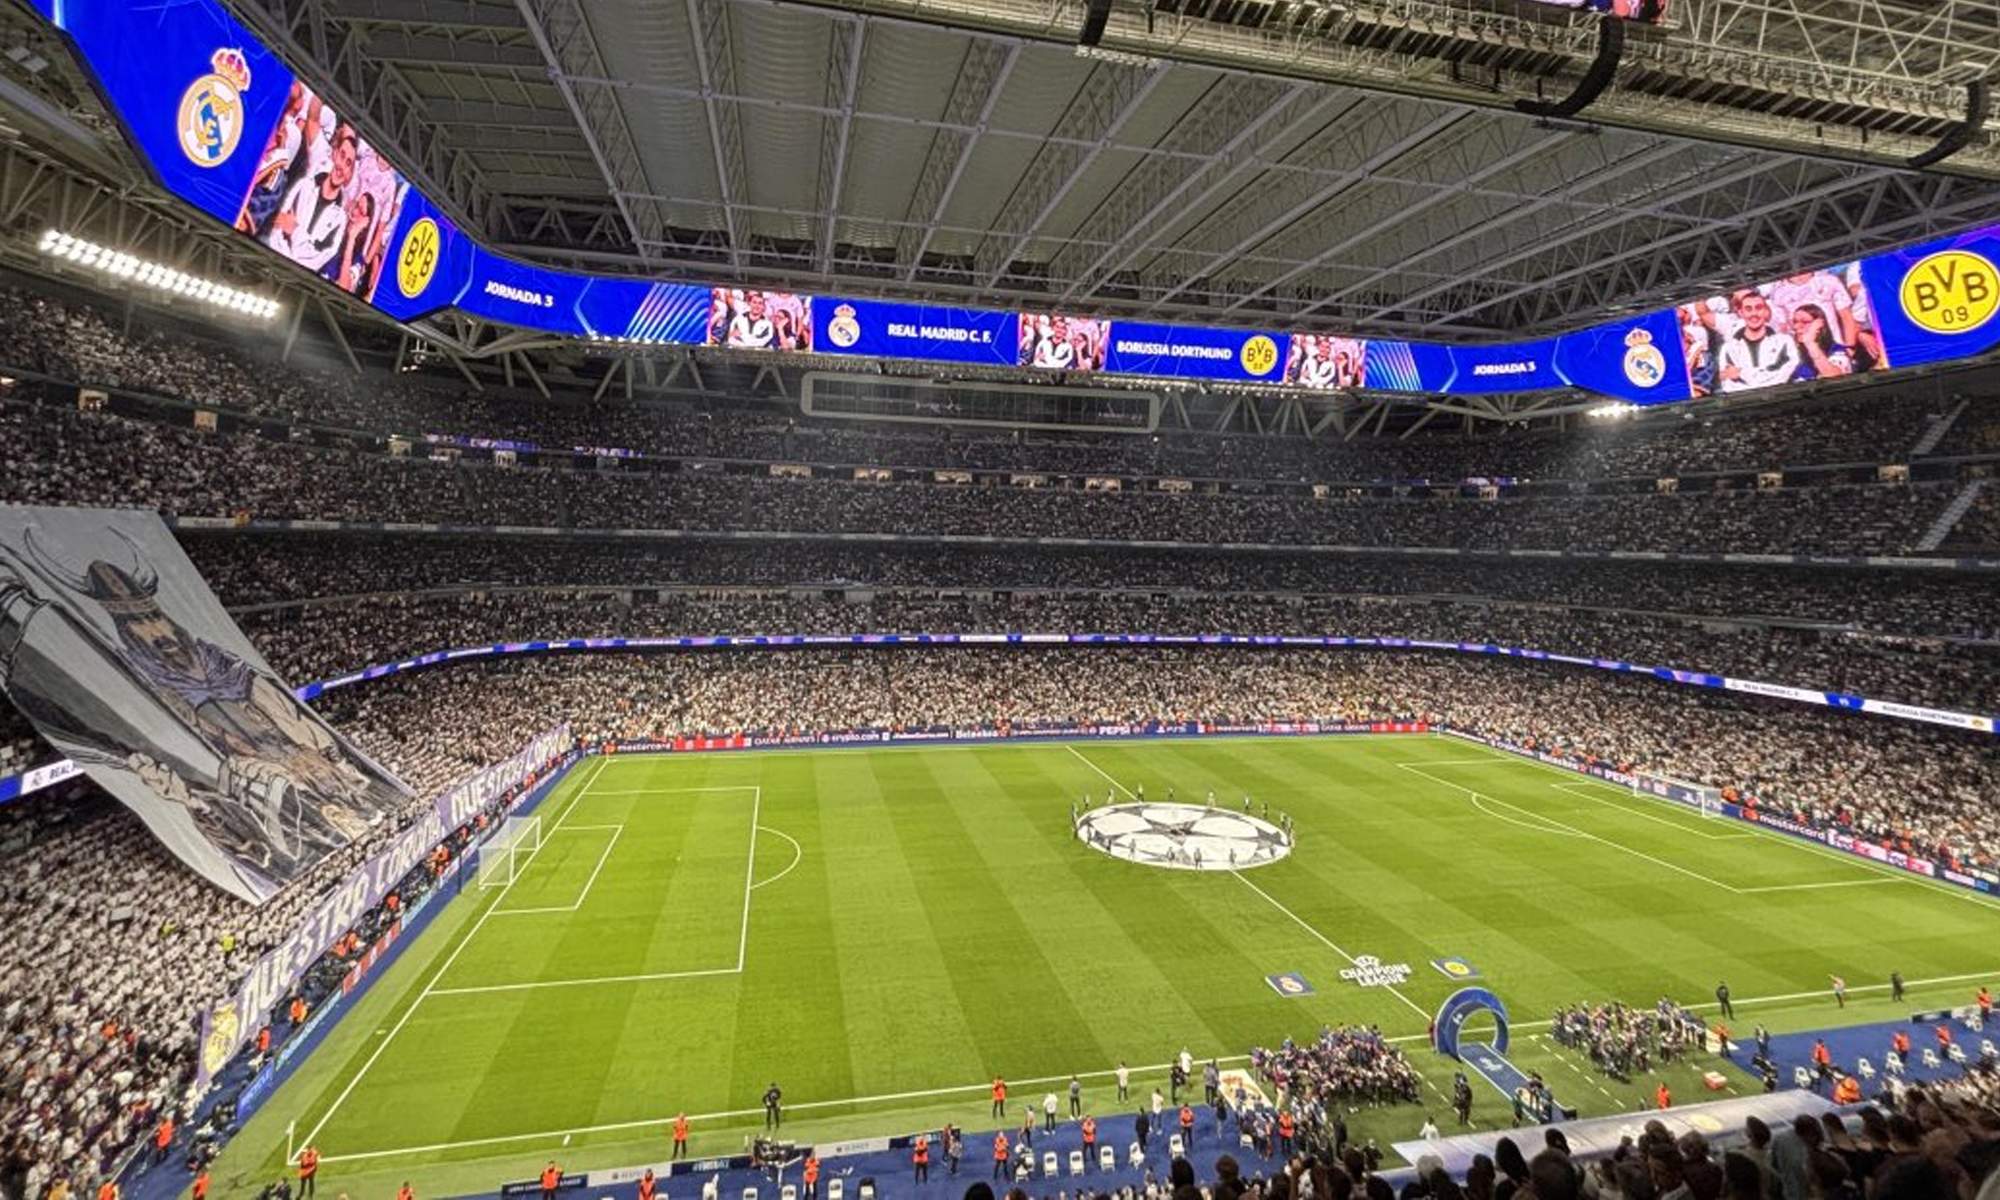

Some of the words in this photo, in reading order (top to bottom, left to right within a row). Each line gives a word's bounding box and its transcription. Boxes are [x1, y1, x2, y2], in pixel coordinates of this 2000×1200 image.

[405, 226, 433, 277] BVB
[484, 280, 542, 305] JORNADA
[544, 294, 554, 307] 3
[1914, 260, 1989, 312] BVB
[1942, 305, 1969, 324] 09
[888, 323, 918, 338] REAL
[920, 326, 968, 342] MADRID
[969, 331, 981, 343] C.
[1117, 340, 1169, 355] BORUSSIA
[1171, 344, 1233, 361] DORTMUND
[1247, 340, 1273, 363] BVB
[1473, 362, 1527, 376] JORNADA
[1527, 361, 1536, 372] 3
[832, 732, 879, 742] crypto.com
[1100, 726, 1131, 735] PEPSI
[617, 741, 671, 751] mastercard
[1759, 815, 1825, 840] mastercard
[1340, 963, 1412, 979] CHAMPIONS
[1358, 973, 1407, 987] LEAGUE
